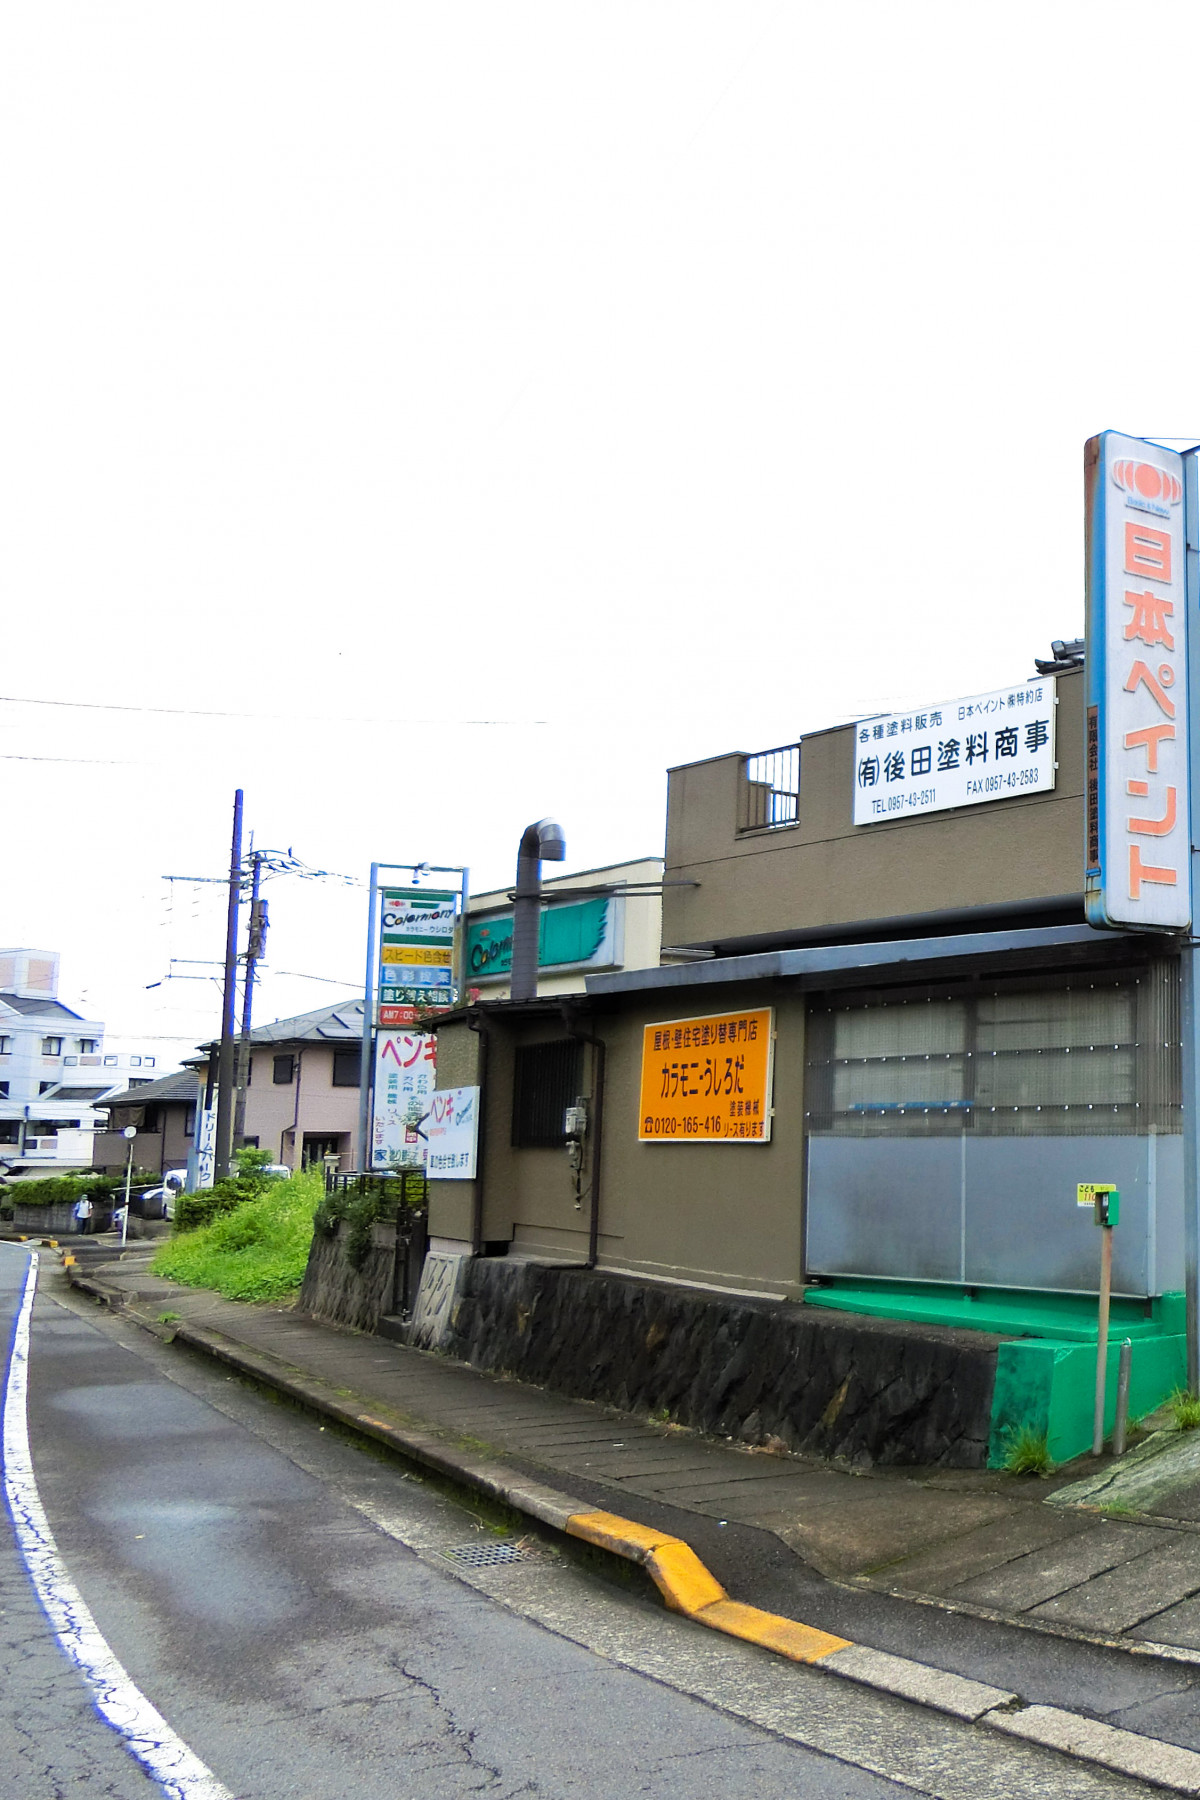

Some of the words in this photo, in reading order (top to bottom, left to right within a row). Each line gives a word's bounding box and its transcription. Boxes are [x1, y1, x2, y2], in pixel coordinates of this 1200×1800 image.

[859, 711, 942, 743] 各種塗料販売
[1123, 521, 1178, 901] 日本ペイント
[1089, 716, 1098, 771] 有限会社
[966, 779, 984, 796] FAX
[985, 767, 1039, 792] 0957-43-2583
[872, 799, 887, 814] TEL
[888, 788, 936, 811] 0957-43-2511
[1089, 778, 1099, 864] 後田塗料商事
[382, 1034, 437, 1068] ペンキ
[655, 1115, 721, 1134] 0120-165-416
